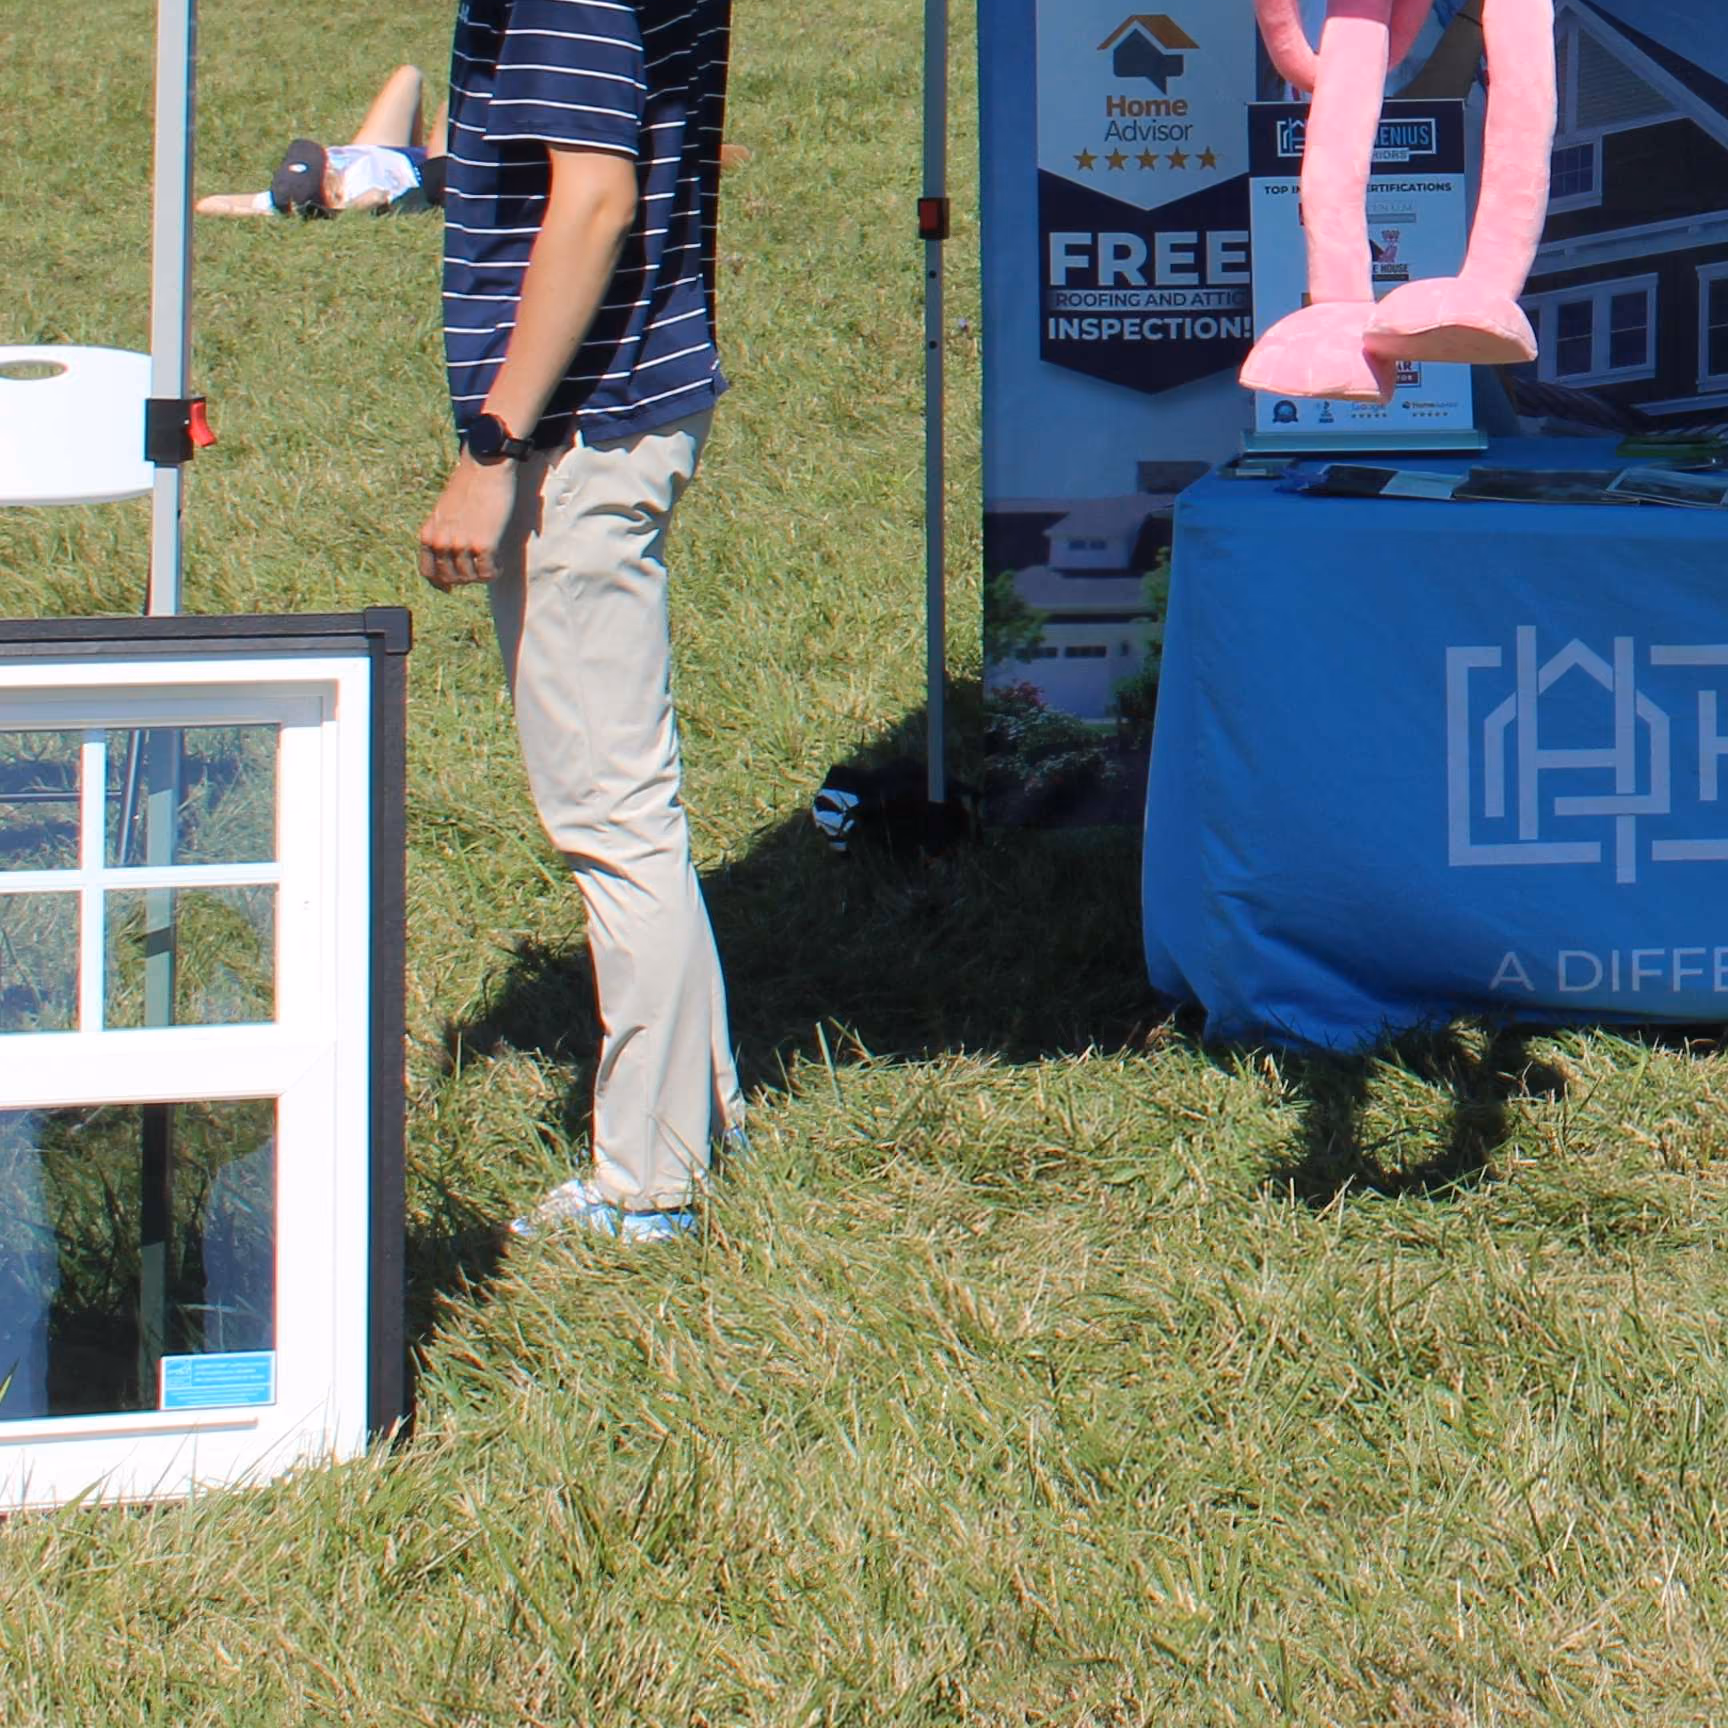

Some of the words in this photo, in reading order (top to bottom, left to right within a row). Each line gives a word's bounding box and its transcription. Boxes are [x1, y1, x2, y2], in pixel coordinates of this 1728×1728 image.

[1105, 94, 1189, 118] Home
[1103, 121, 1194, 143] Advisor
[1264, 184, 1293, 196] TOP
[1049, 231, 1249, 287] FREE
[1056, 290, 1142, 308] ROOFING
[1144, 290, 1187, 307] AND
[1190, 289, 1248, 308] ATTIC
[1047, 316, 1252, 341] INSPECTION!
[1488, 950, 1536, 991] A
